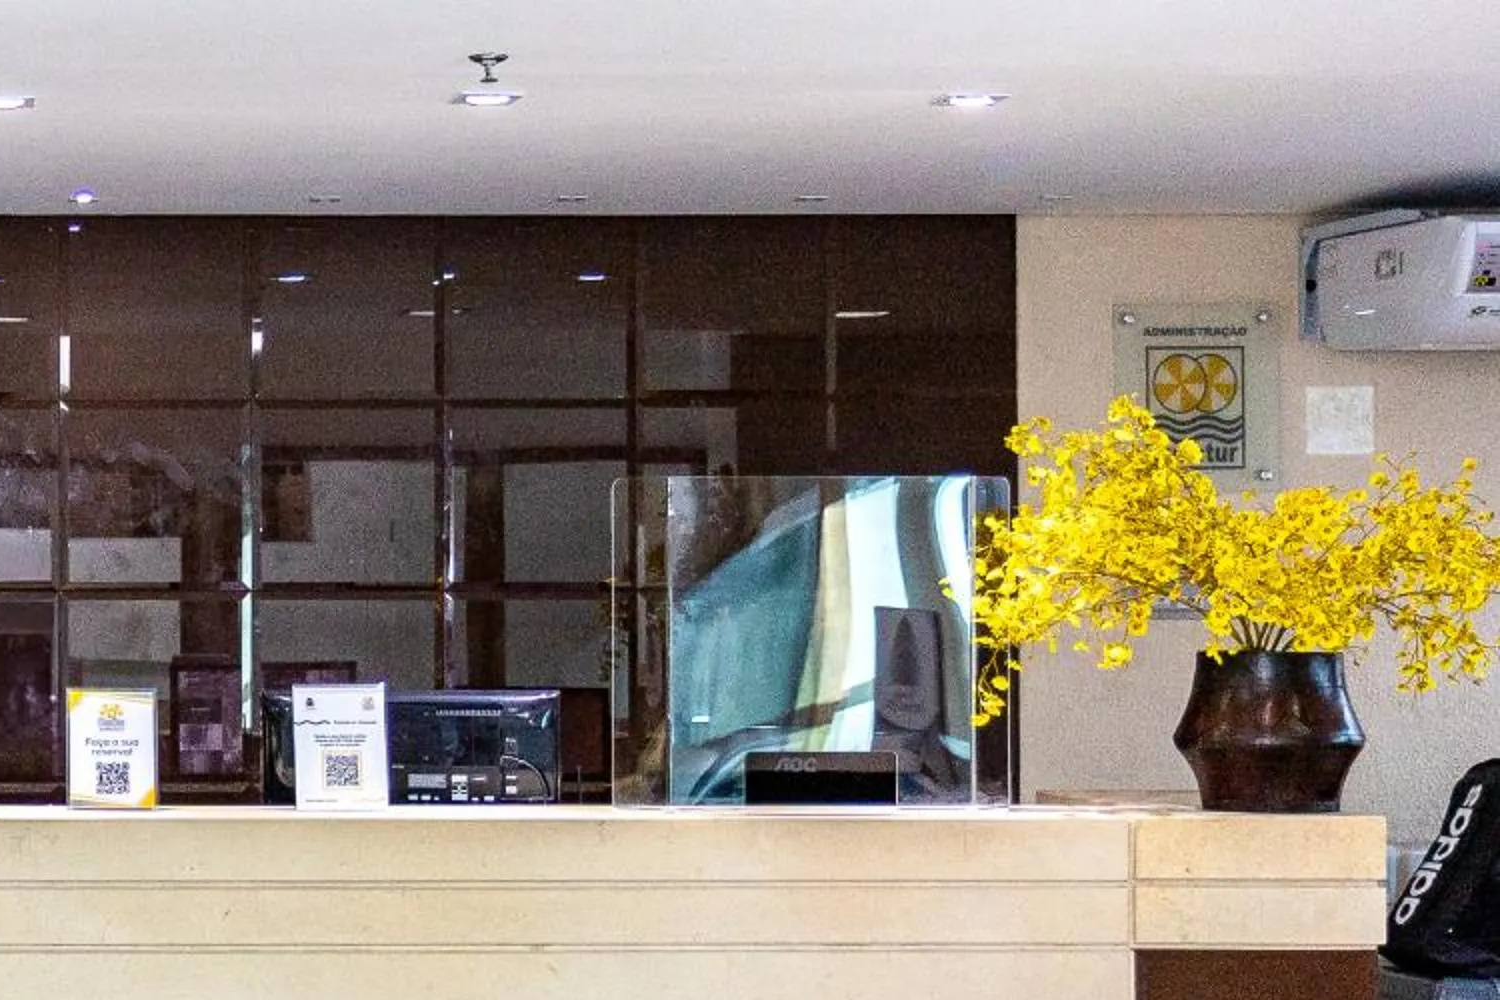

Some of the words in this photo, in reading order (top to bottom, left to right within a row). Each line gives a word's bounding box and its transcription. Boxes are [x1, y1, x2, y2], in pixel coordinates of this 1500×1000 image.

[1143, 326, 1248, 337] ADMINISTRAÇÃO
[85, 737, 110, 748] Faça
[112, 739, 119, 747] a
[121, 739, 140, 747] sua
[1395, 783, 1483, 926] adidas
